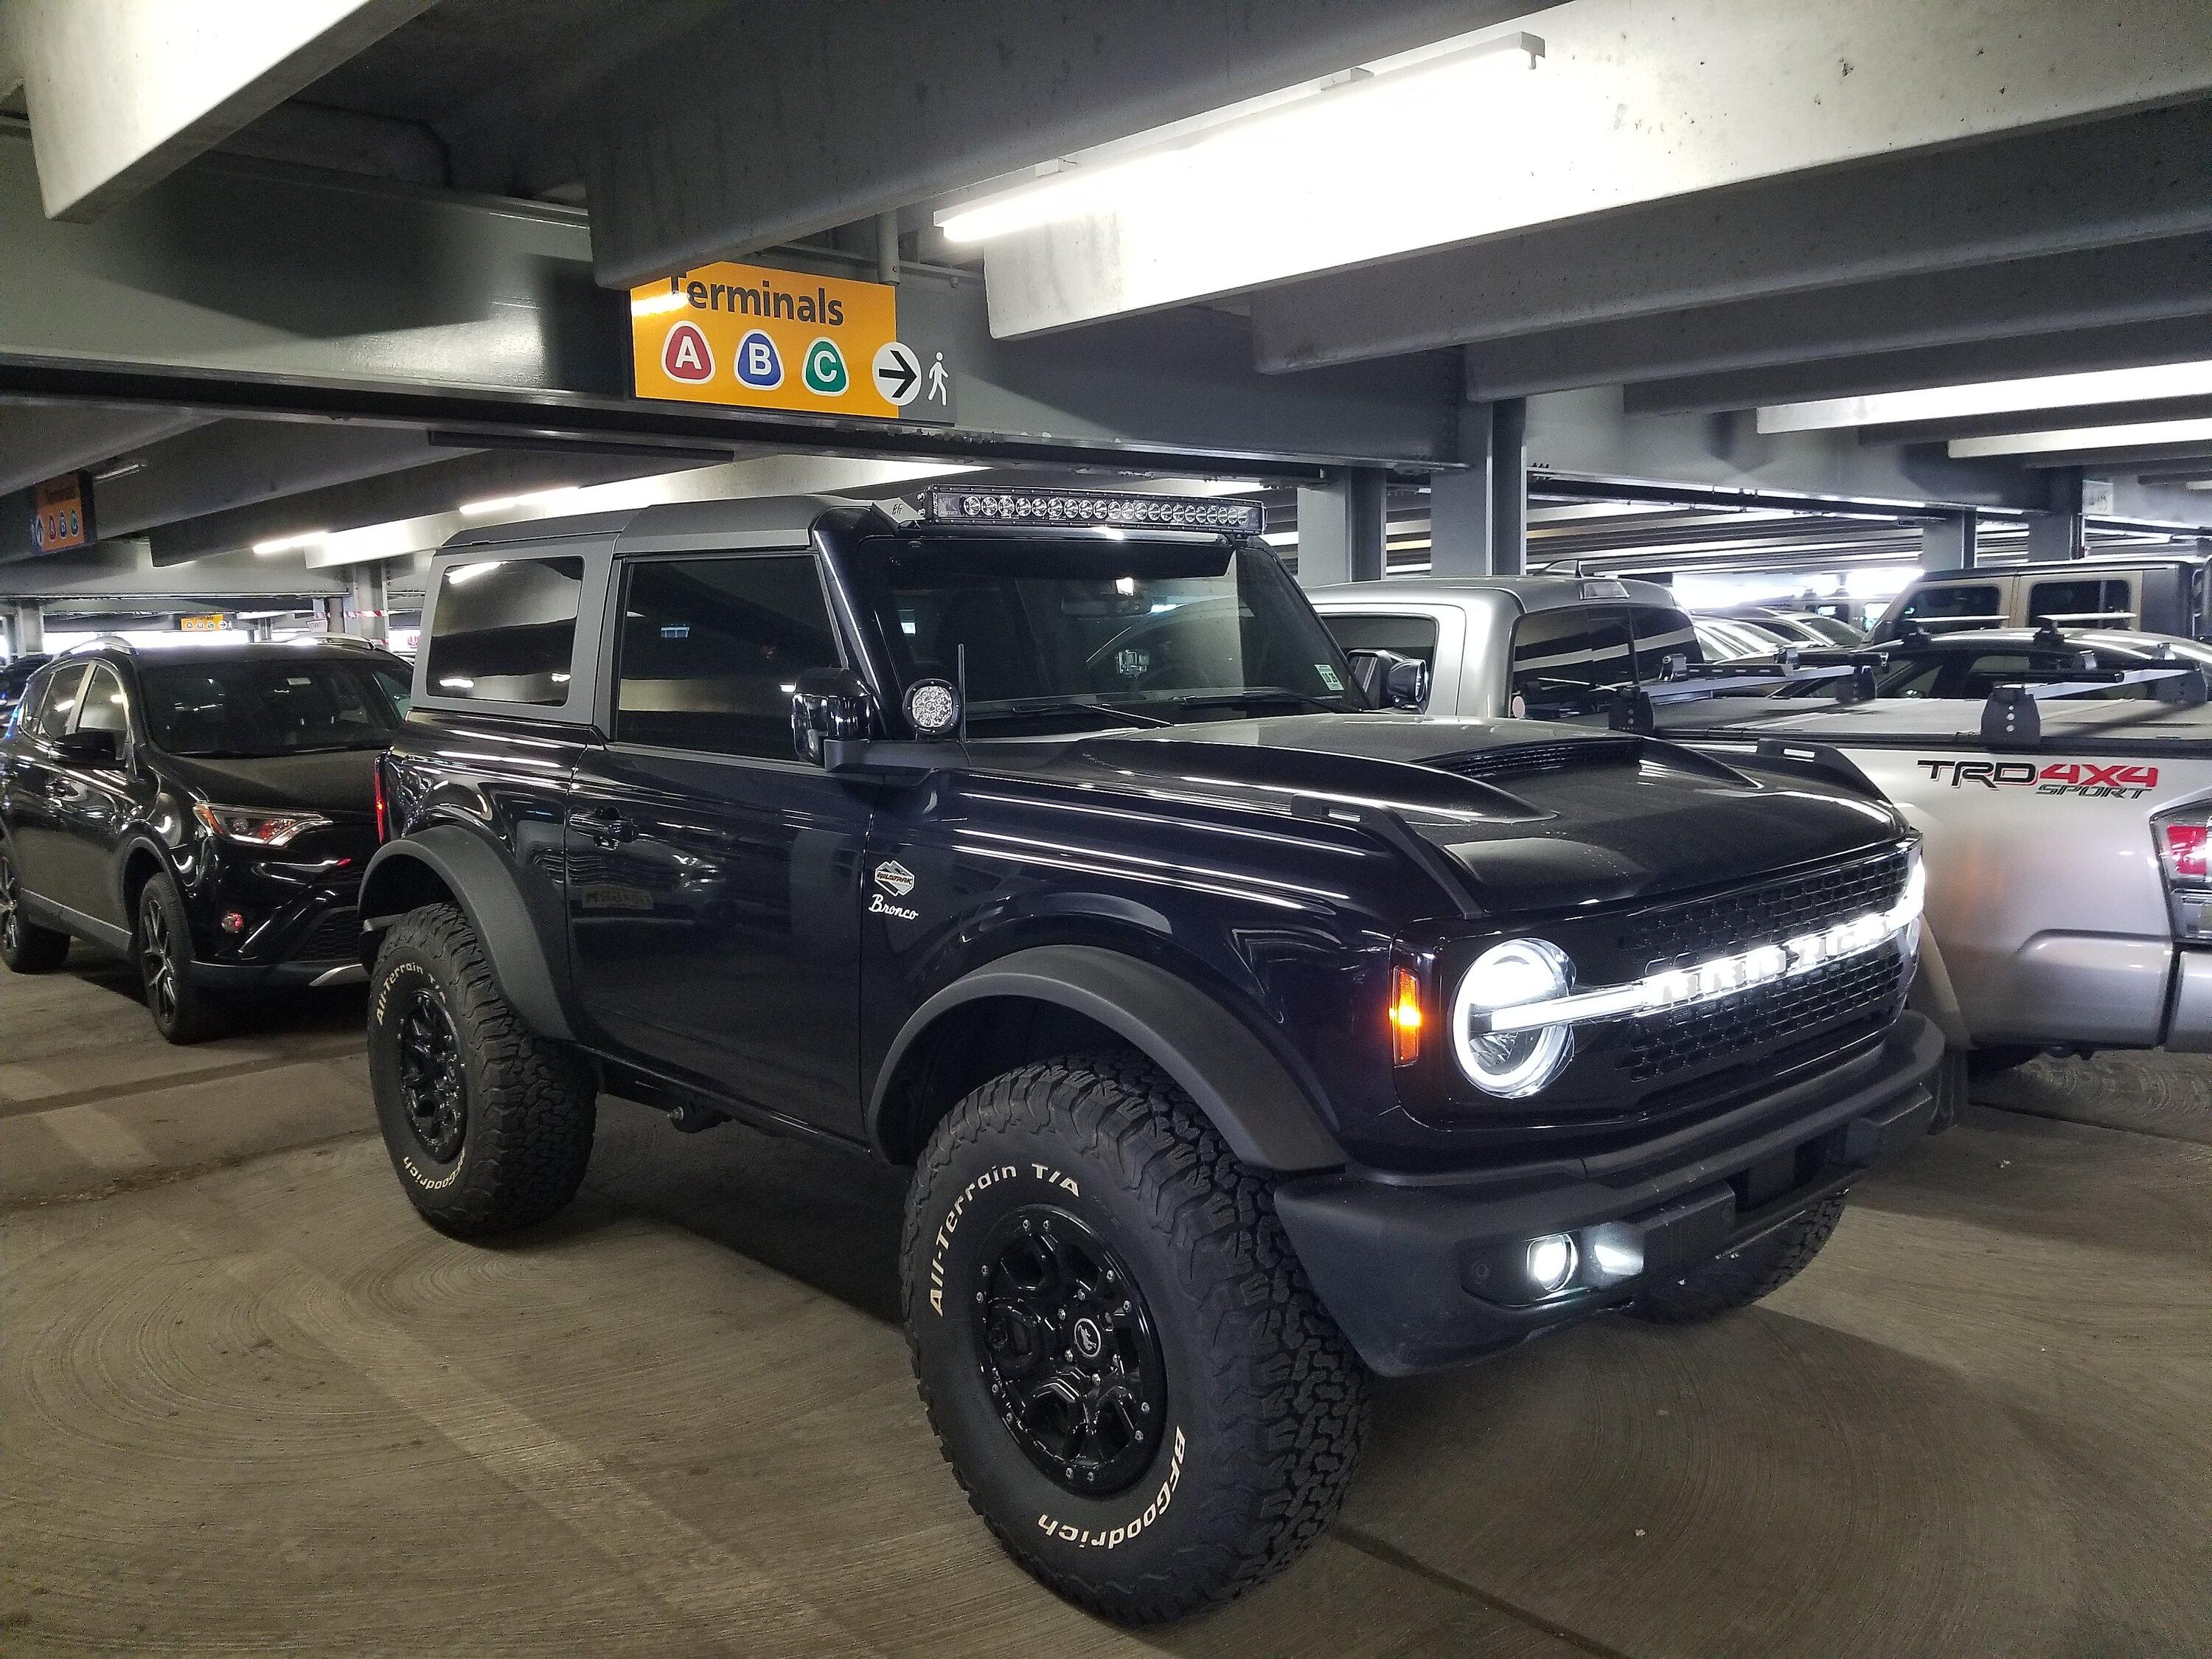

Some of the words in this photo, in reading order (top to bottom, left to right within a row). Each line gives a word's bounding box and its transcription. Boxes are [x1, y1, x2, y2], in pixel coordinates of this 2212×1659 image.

[669, 274, 844, 326] Terminals
[674, 335, 703, 369] A
[748, 344, 772, 376] B
[813, 350, 838, 383] C
[1917, 759, 2038, 790] TRD
[2035, 785, 2152, 799] SPORT
[868, 894, 919, 920] Bronco
[376, 961, 424, 1026] All-Terrain
[930, 1165, 1018, 1318] All-Terrain
[1031, 1162, 1079, 1198] T/A
[1037, 1425, 1186, 1549] BFGoodrich
